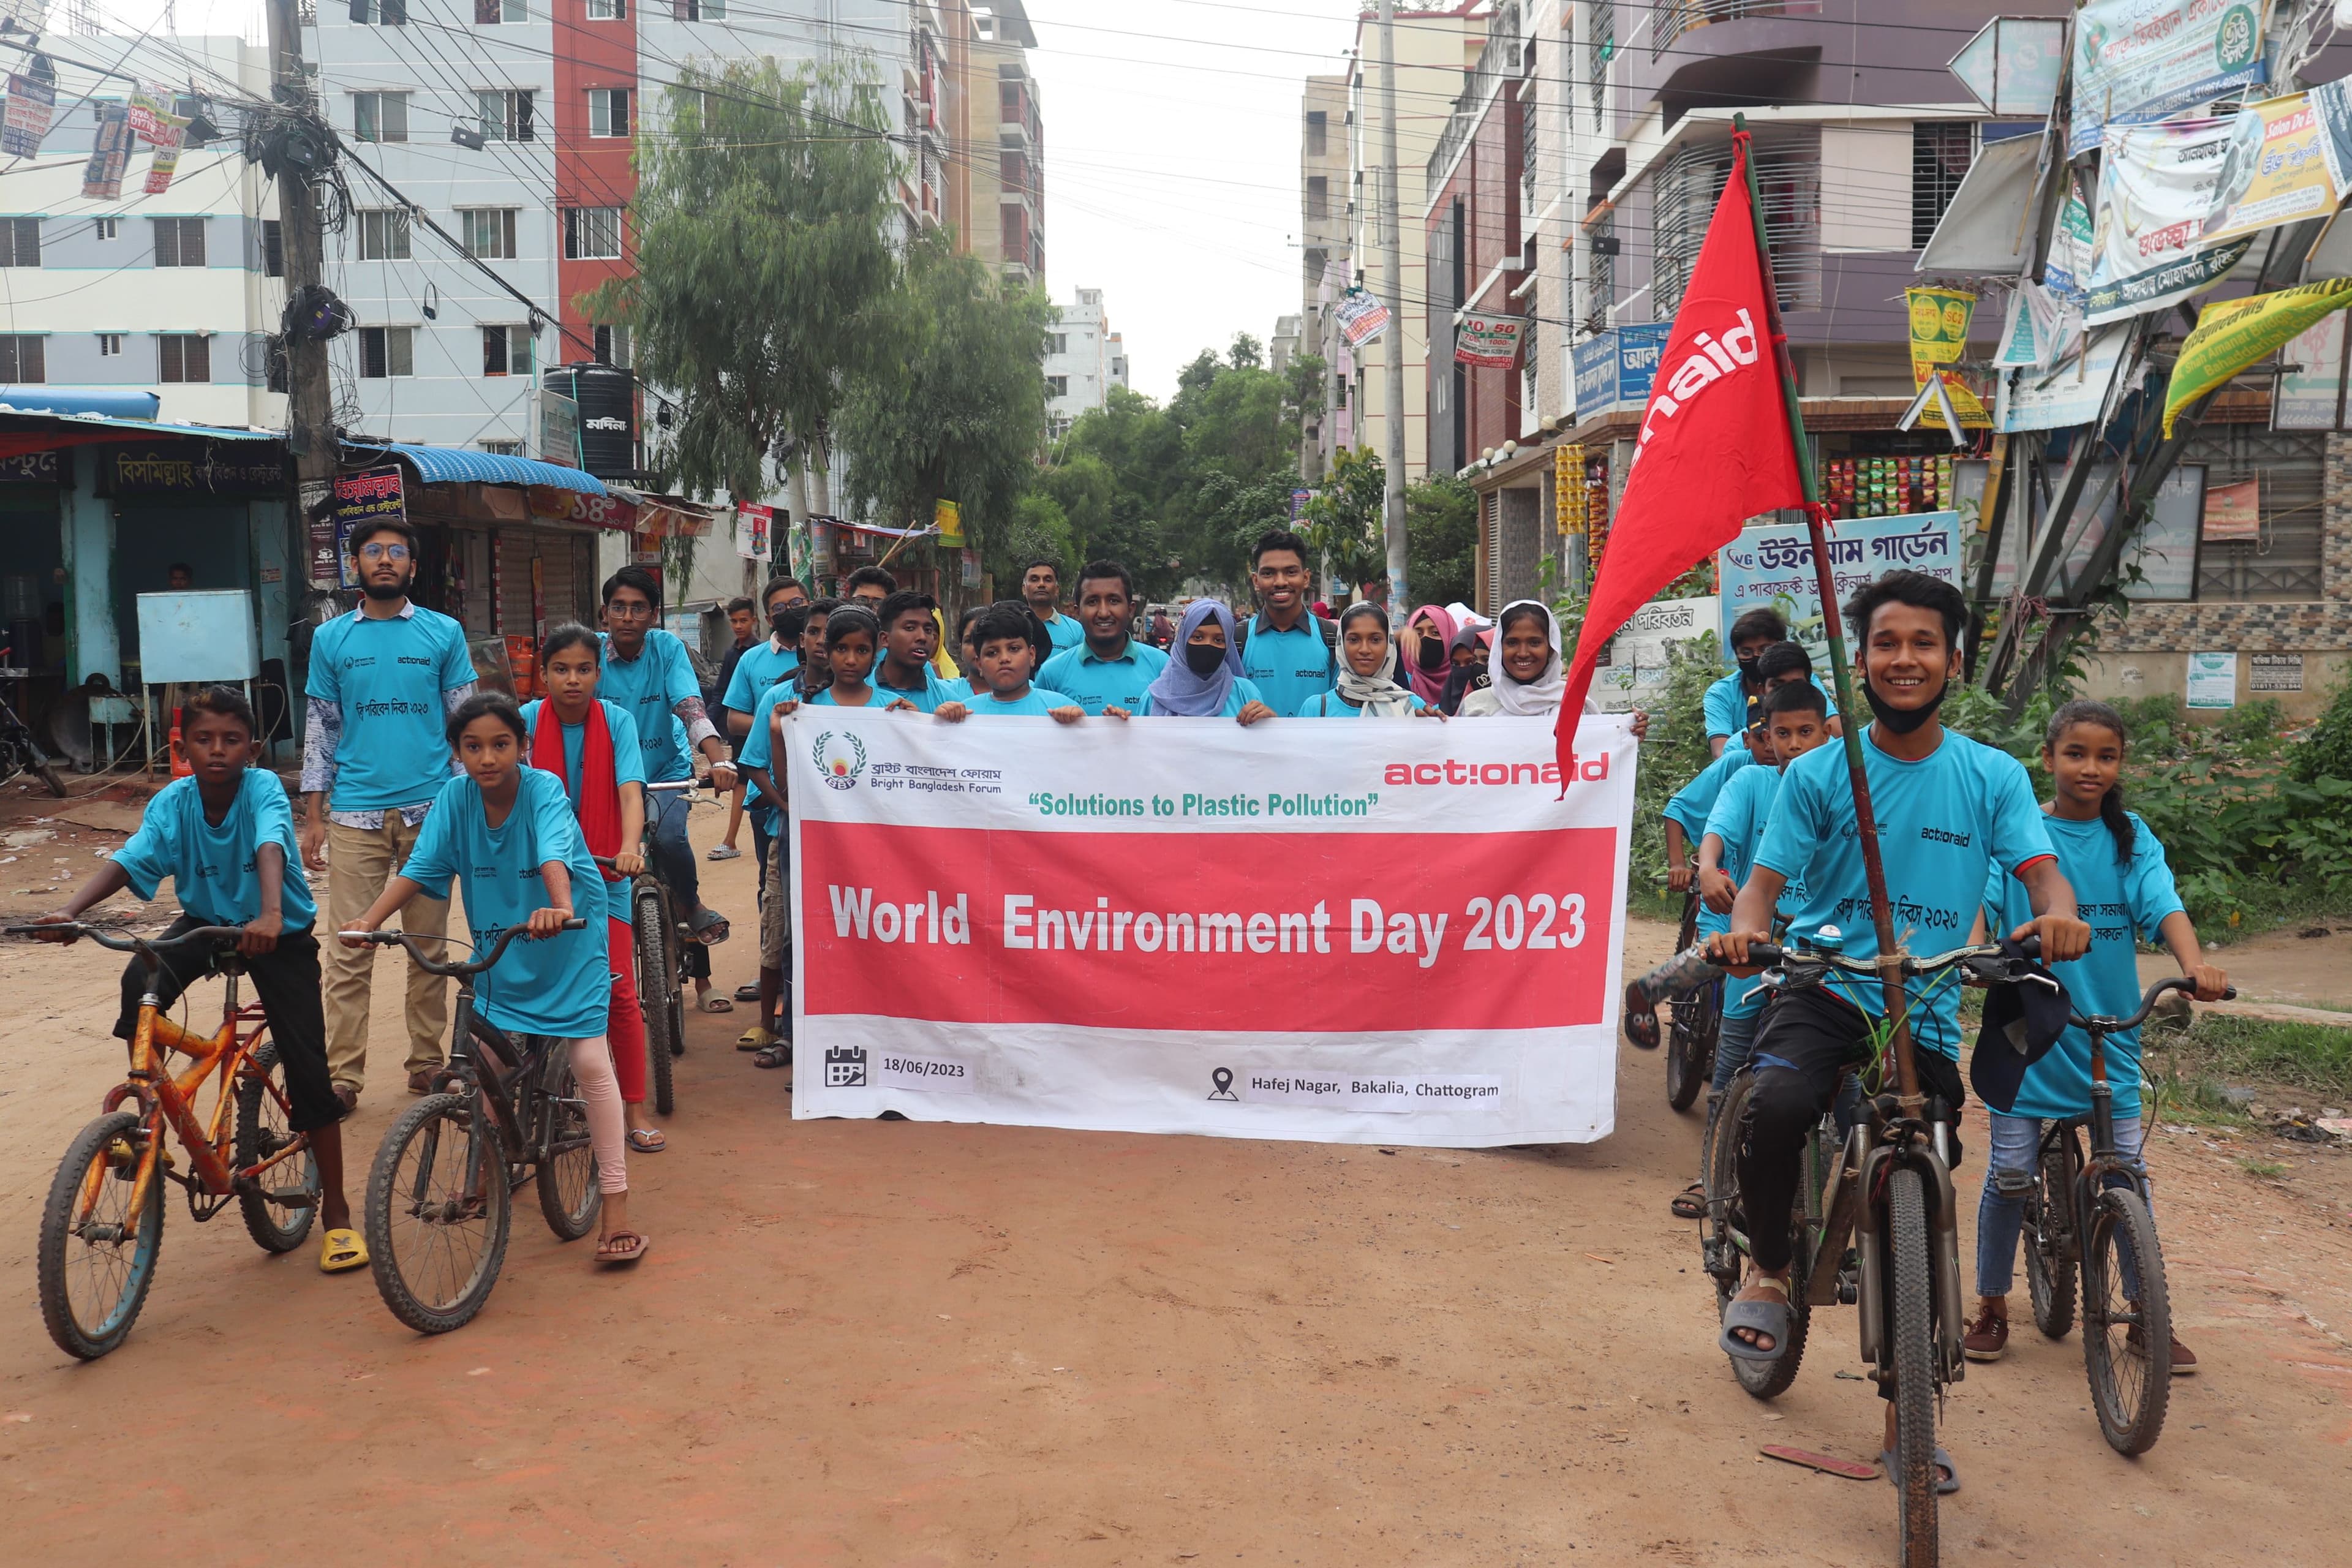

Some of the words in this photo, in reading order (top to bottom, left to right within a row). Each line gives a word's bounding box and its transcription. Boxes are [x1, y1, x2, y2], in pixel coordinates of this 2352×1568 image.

[586, 417, 627, 431] মদিনা
[1872, 521, 1948, 565] গার্ডেন
[1637, 605, 1694, 630] পরিবর্তন
[364, 698, 390, 717] পরিবেশ
[391, 698, 409, 716] দিবস
[871, 762, 902, 775] ব্রাইট
[905, 764, 957, 778] বাংলাদেশ
[960, 768, 1003, 780] ফোরাম
[826, 778, 856, 790] BBF
[871, 778, 904, 790] Bright
[909, 780, 965, 794] Bangladesh
[969, 782, 1003, 794] Forum
[1152, 794, 1175, 816] to
[1181, 793, 1261, 816] Plastic
[1898, 894, 1923, 925] দিবস
[1925, 907, 1959, 931] ২০২৩
[827, 884, 971, 946] World
[1003, 894, 1332, 954] Environment
[1350, 898, 1449, 968] Day
[1463, 892, 1586, 951] 2023
[883, 1057, 965, 1079] 18/06/2023
[1251, 1076, 1291, 1095] Hafej
[1294, 1078, 1341, 1096] Nagar,
[1351, 1080, 1409, 1098] Bakalia,
[1415, 1082, 1499, 1099] Chattogram
